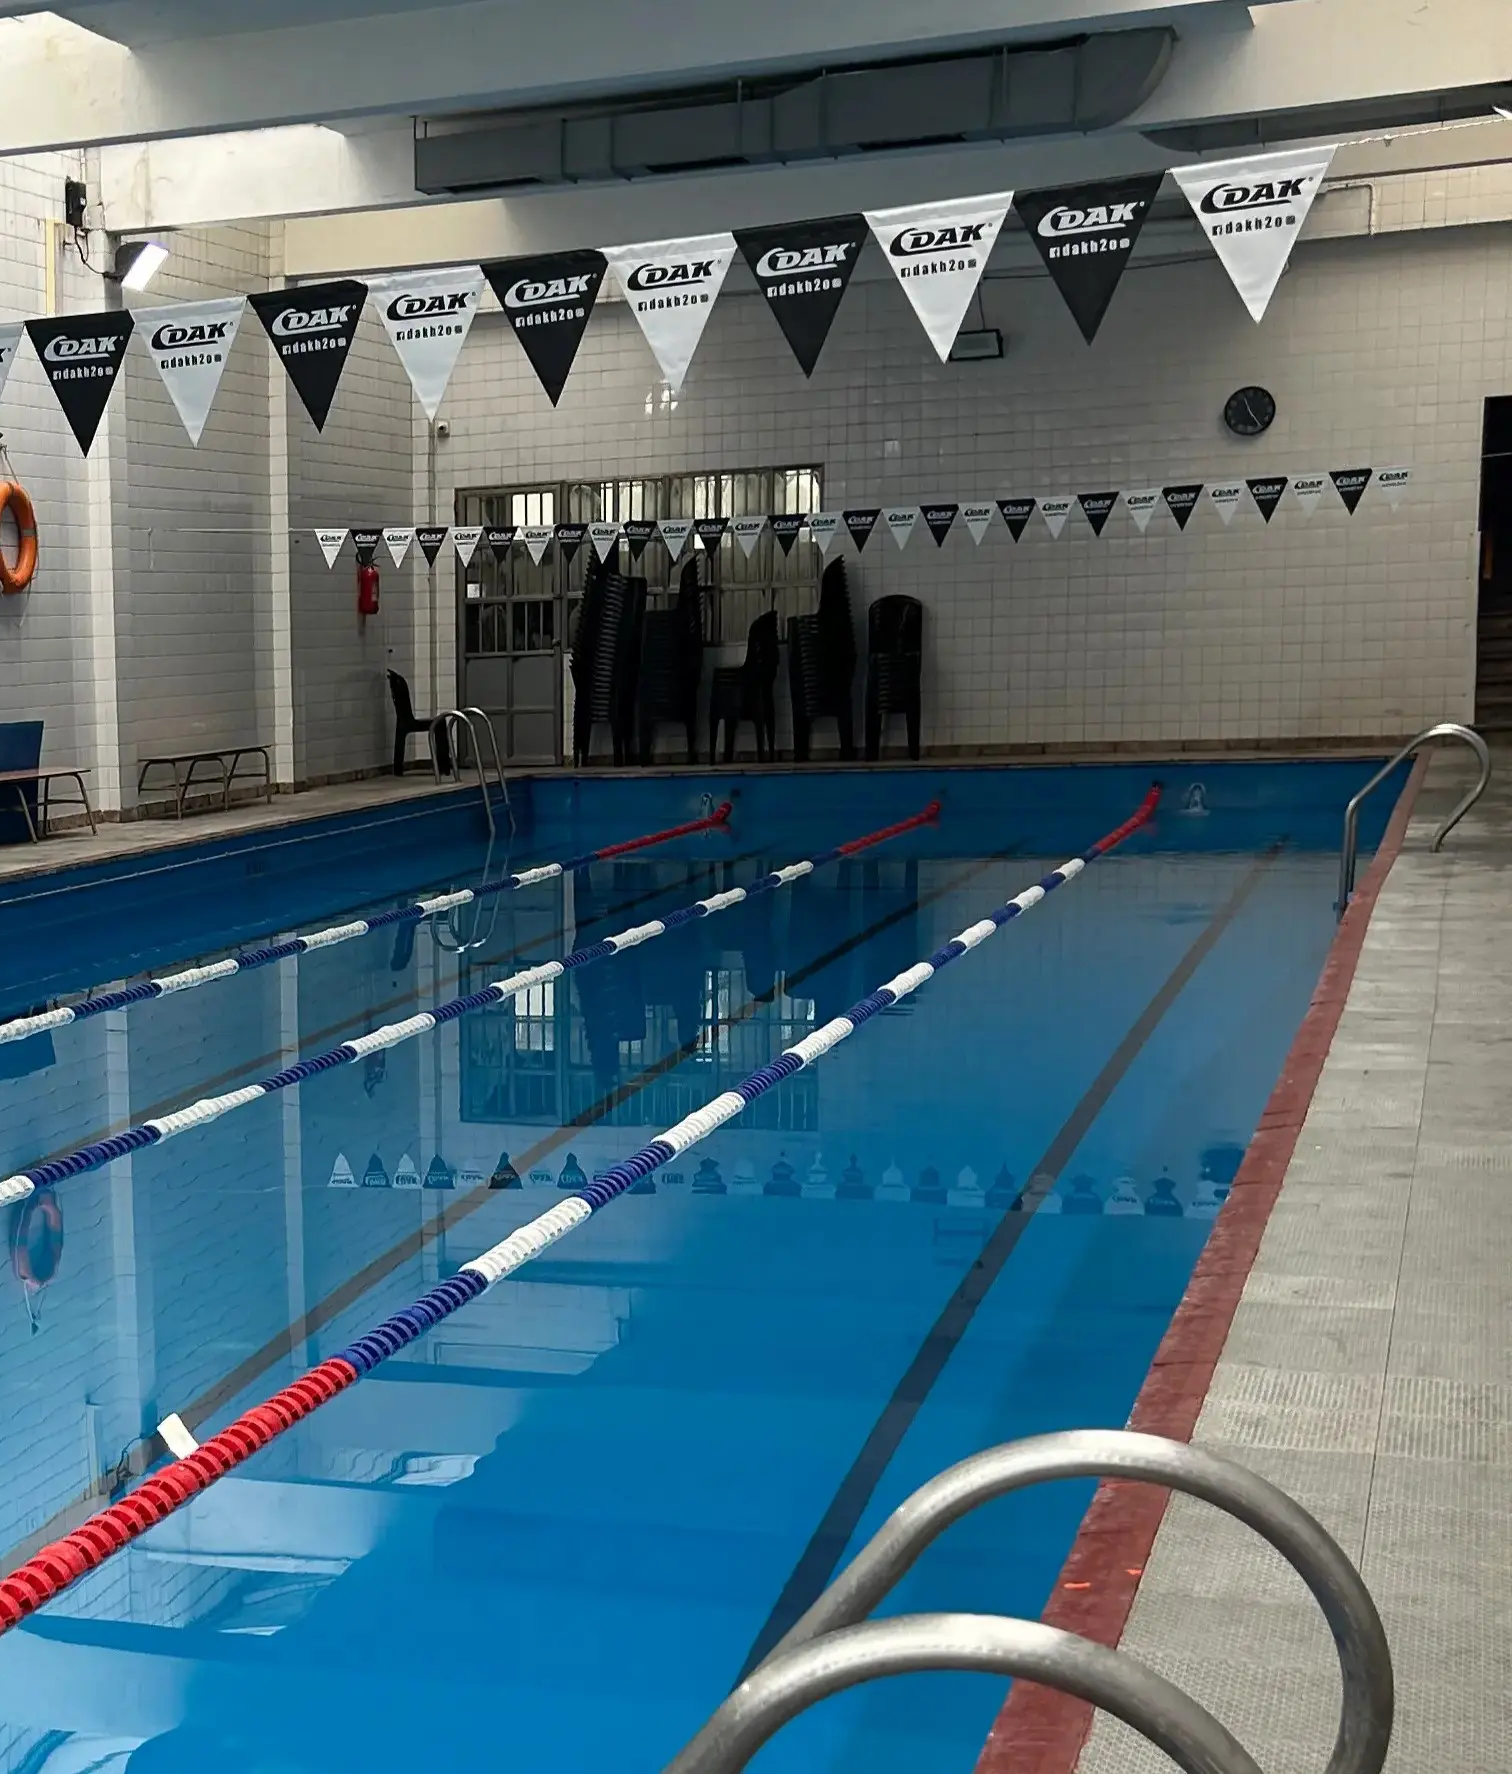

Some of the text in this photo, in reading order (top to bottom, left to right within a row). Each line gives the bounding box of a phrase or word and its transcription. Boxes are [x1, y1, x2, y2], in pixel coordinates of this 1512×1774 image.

[1222, 179, 1306, 207] DAK
[1055, 201, 1137, 231] DAK
[910, 223, 987, 249] DAK
[775, 243, 849, 270] DAK
[645, 260, 715, 284] DAK
[523, 274, 590, 301] DAK
[404, 292, 468, 314] DAK
[289, 306, 349, 328] DAK
[168, 321, 228, 342] DAK
[59, 336, 117, 355] DAK
